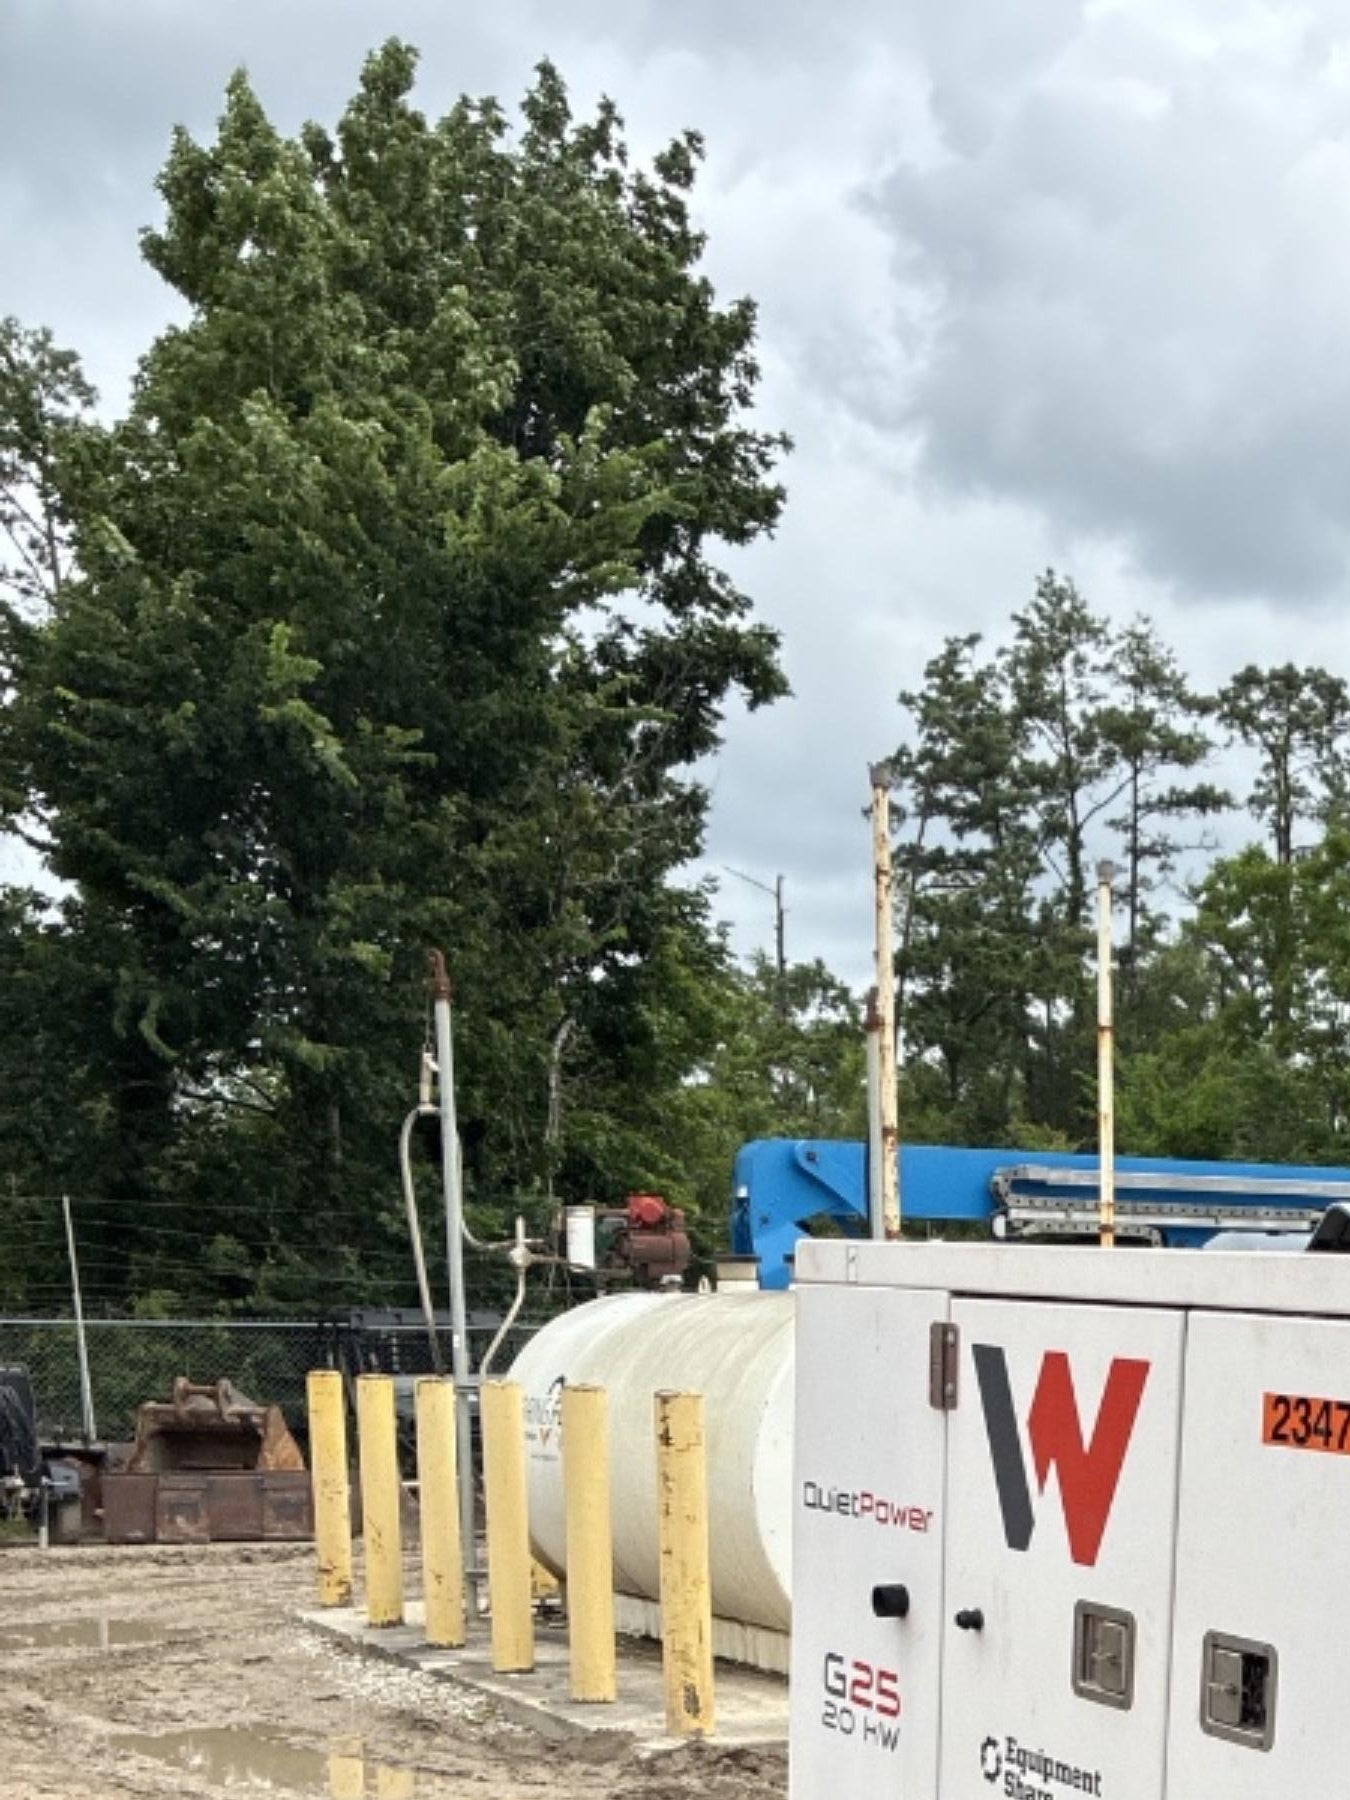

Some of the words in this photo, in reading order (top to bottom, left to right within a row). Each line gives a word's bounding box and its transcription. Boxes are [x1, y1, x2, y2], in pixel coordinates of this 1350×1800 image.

[803, 1481, 933, 1532] QuietPower
[823, 1652, 901, 1717] G25
[822, 1700, 855, 1735] 20
[1005, 1736, 1101, 1798] Equipment
